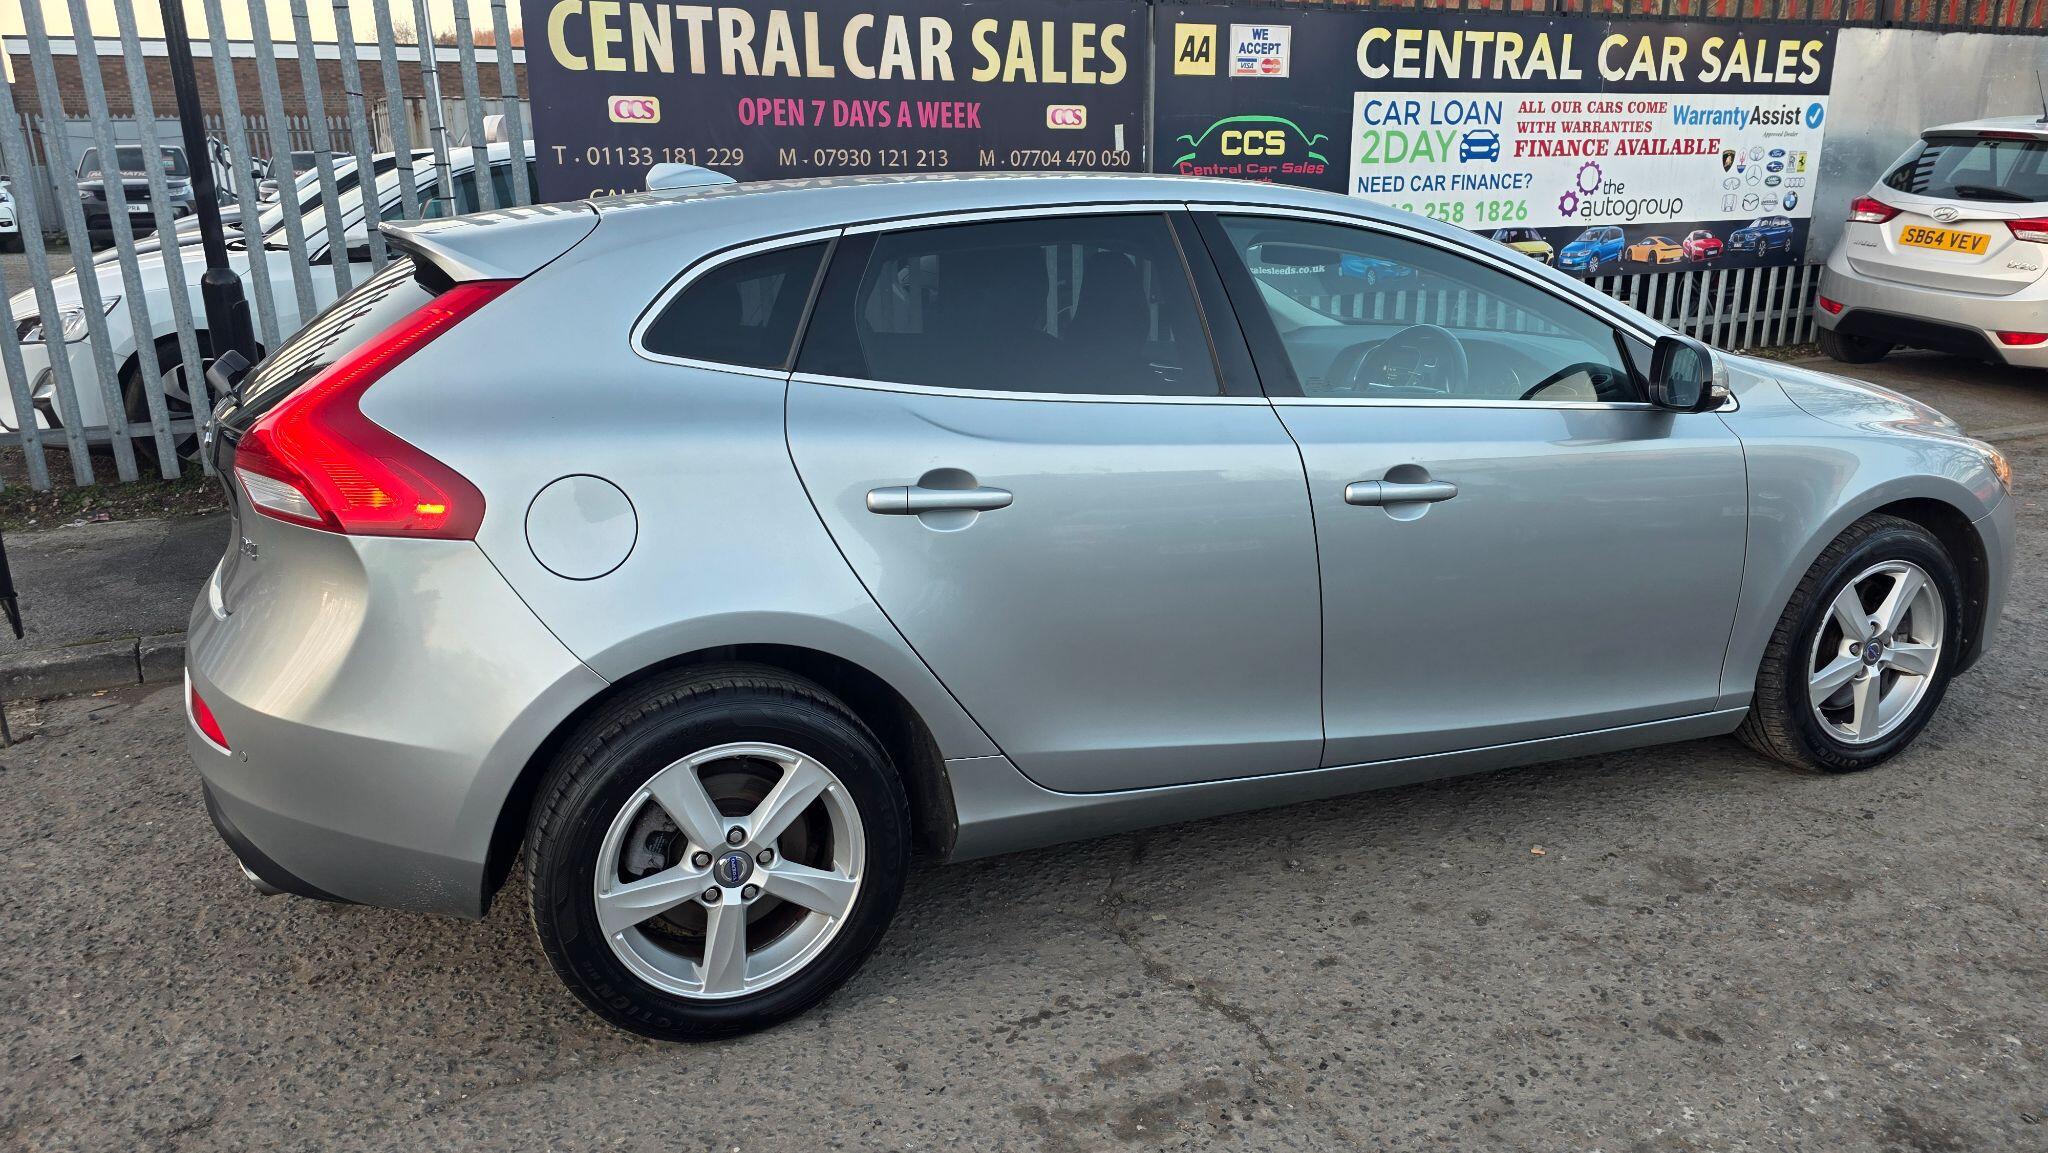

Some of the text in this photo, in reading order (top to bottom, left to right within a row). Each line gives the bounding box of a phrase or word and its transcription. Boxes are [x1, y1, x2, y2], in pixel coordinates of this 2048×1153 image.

[547, 0, 1127, 85] CENTRAL CAR SALES
[1252, 28, 1269, 40] WE
[1180, 35, 1210, 62] AA
[1239, 42, 1281, 54] ACCEPT
[1356, 27, 1824, 85] CENTRAL CAR SALES
[614, 99, 655, 119] CCS
[738, 97, 982, 128] OPEN 7 DAYS A WEEK
[1051, 108, 1082, 126] CCS
[1364, 99, 1503, 126] CAR LOAN
[1518, 101, 1668, 114] ALL OUR CARS COME
[1516, 120, 1653, 134] WITH WARRANTIES
[1221, 130, 1286, 156] CCS
[1361, 129, 1458, 164] 2DAY
[1513, 138, 1721, 158] FINANCE AVAILABLE
[586, 146, 654, 166] 01133
[663, 147, 697, 165] 181
[706, 147, 745, 166] 229
[814, 149, 871, 167] 07930
[879, 149, 908, 167] 121
[916, 149, 949, 167] 213
[1010, 149, 1061, 167] 07704
[1066, 149, 1096, 167] 470
[1101, 149, 1131, 167] 050
[1179, 161, 1325, 176] Central Car Sales
[1358, 173, 1533, 193] NEED CAR FINANCE?
[1603, 178, 1625, 195] the
[1424, 201, 1465, 223] 258
[1475, 199, 1528, 223] 1826
[1580, 196, 1683, 221] autogroup
[1905, 228, 1983, 250] SB64 VEV
